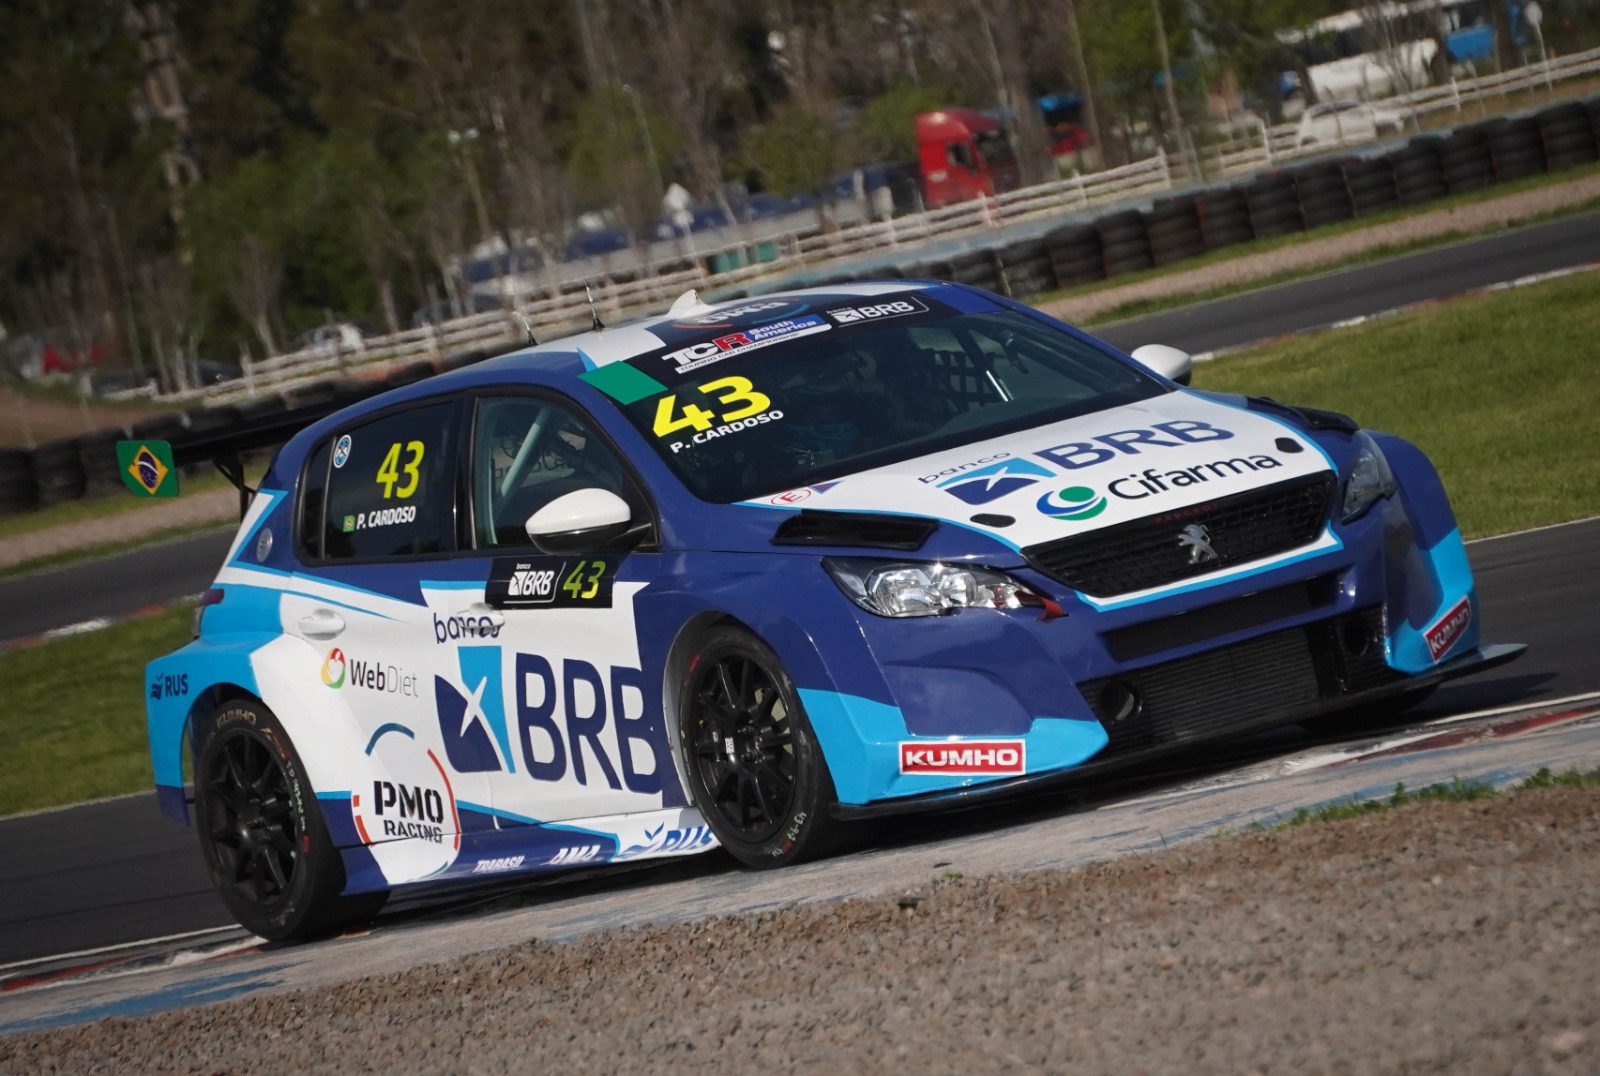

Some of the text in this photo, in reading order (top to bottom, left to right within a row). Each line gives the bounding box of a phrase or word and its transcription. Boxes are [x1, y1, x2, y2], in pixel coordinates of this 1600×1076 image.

[748, 319, 795, 336] South
[858, 301, 915, 318] BRB
[661, 332, 753, 368] TCR
[752, 320, 817, 342] America
[680, 332, 801, 373] TOURING CAR CHAMPIONSHIP
[653, 376, 771, 438] 43
[670, 410, 784, 453] P. CARDOSO
[1032, 420, 1235, 470] BRB
[376, 440, 425, 499] 43
[917, 452, 1011, 484] banco
[1107, 454, 1284, 500] Cifarma
[356, 505, 417, 530] P. CARDOSO
[522, 560, 607, 599] BRB 43
[165, 673, 189, 698] RUS
[350, 659, 418, 698] WebDiet
[515, 652, 663, 795] BRB
[905, 749, 1019, 767] KUMHO
[373, 780, 444, 824] PMO
[383, 819, 443, 844] RACING
